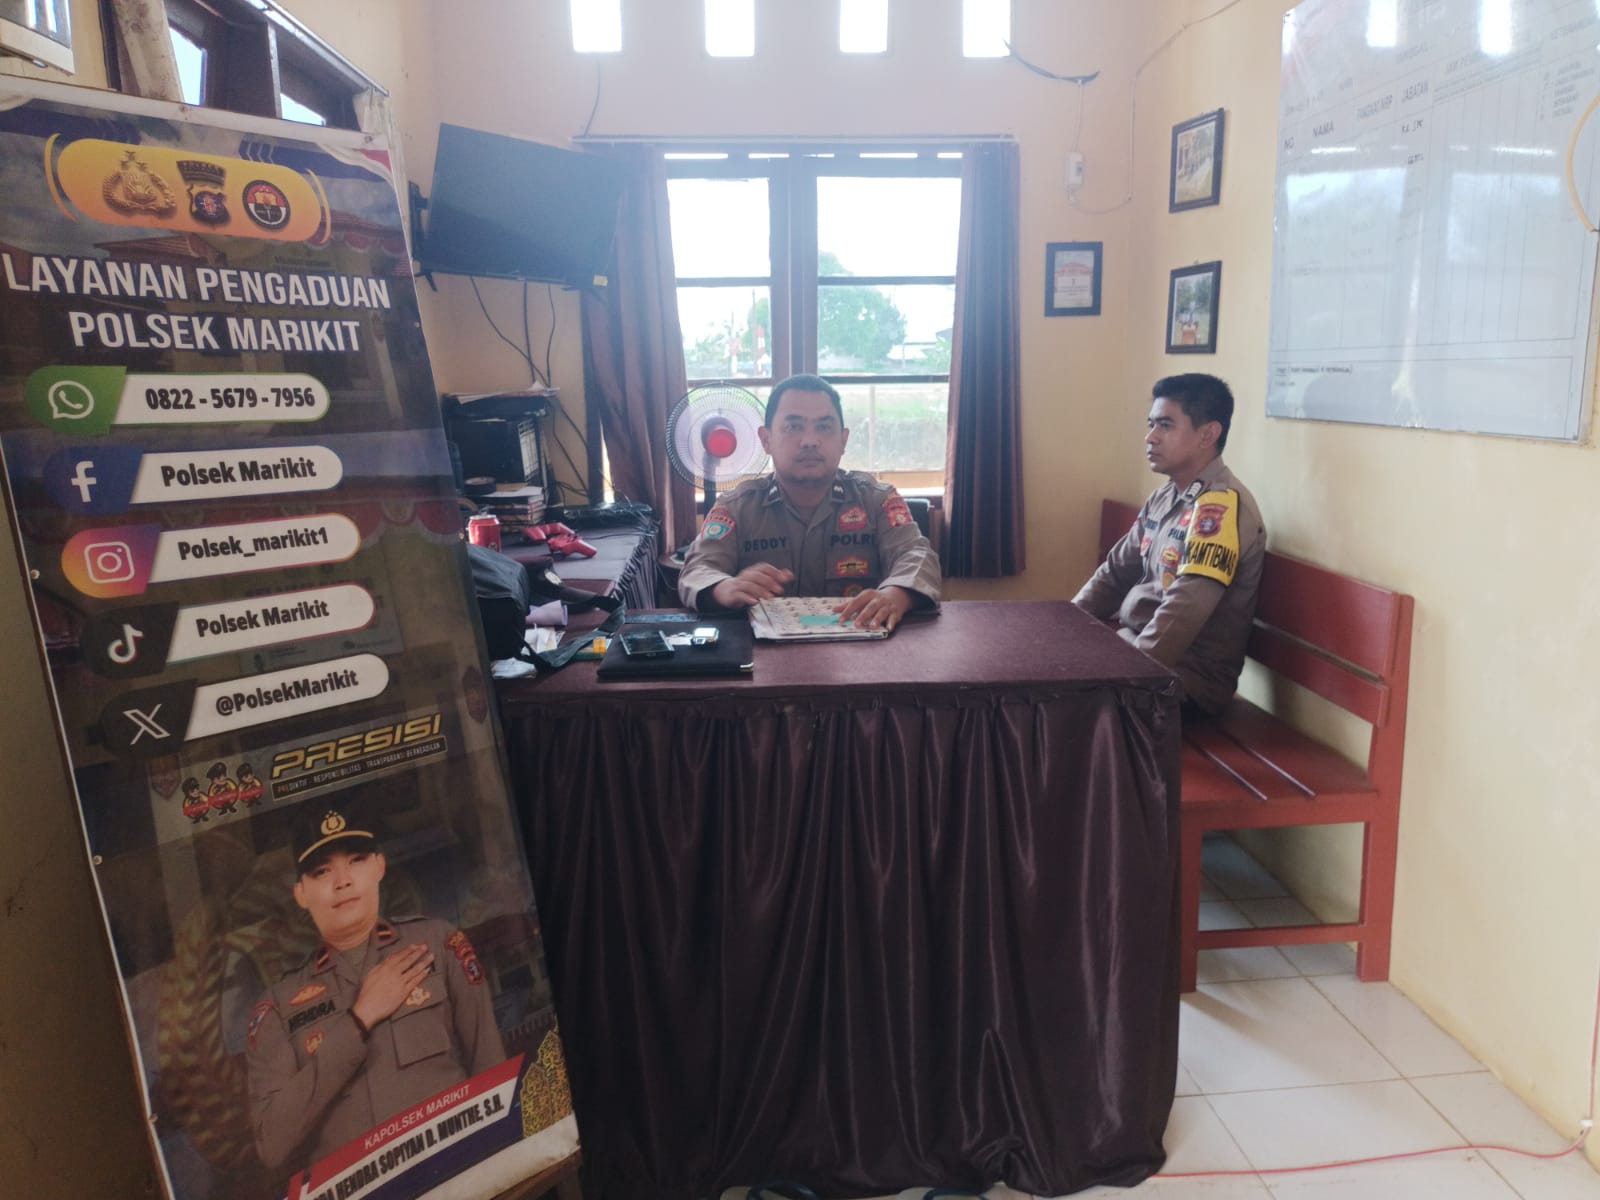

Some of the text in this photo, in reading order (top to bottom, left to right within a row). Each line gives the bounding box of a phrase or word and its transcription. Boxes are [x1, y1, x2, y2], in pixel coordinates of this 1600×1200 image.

[2, 254, 391, 309] LAYANAN PENGADUAN
[69, 311, 360, 352] POLSEK MARIKIT
[161, 458, 317, 487] Polsek Marikit
[178, 527, 328, 561] Polsek_marikit1
[745, 536, 786, 552] DEDDY
[831, 533, 874, 547] POLRI
[196, 600, 329, 637] Polsek Marikit
[215, 670, 358, 717] @PolsekMarikit
[272, 714, 442, 779] PRESISI
[288, 1000, 336, 1033] HENDRA
[364, 1084, 471, 1150] KAPOLSEK MARIKIT
[334, 1159, 380, 1200] HENDRA
[378, 1136, 424, 1175] SOPIYAN
[426, 1128, 438, 1149] D.
[438, 1108, 483, 1141] MUNTHE,
[484, 1093, 504, 1118] S.H.
